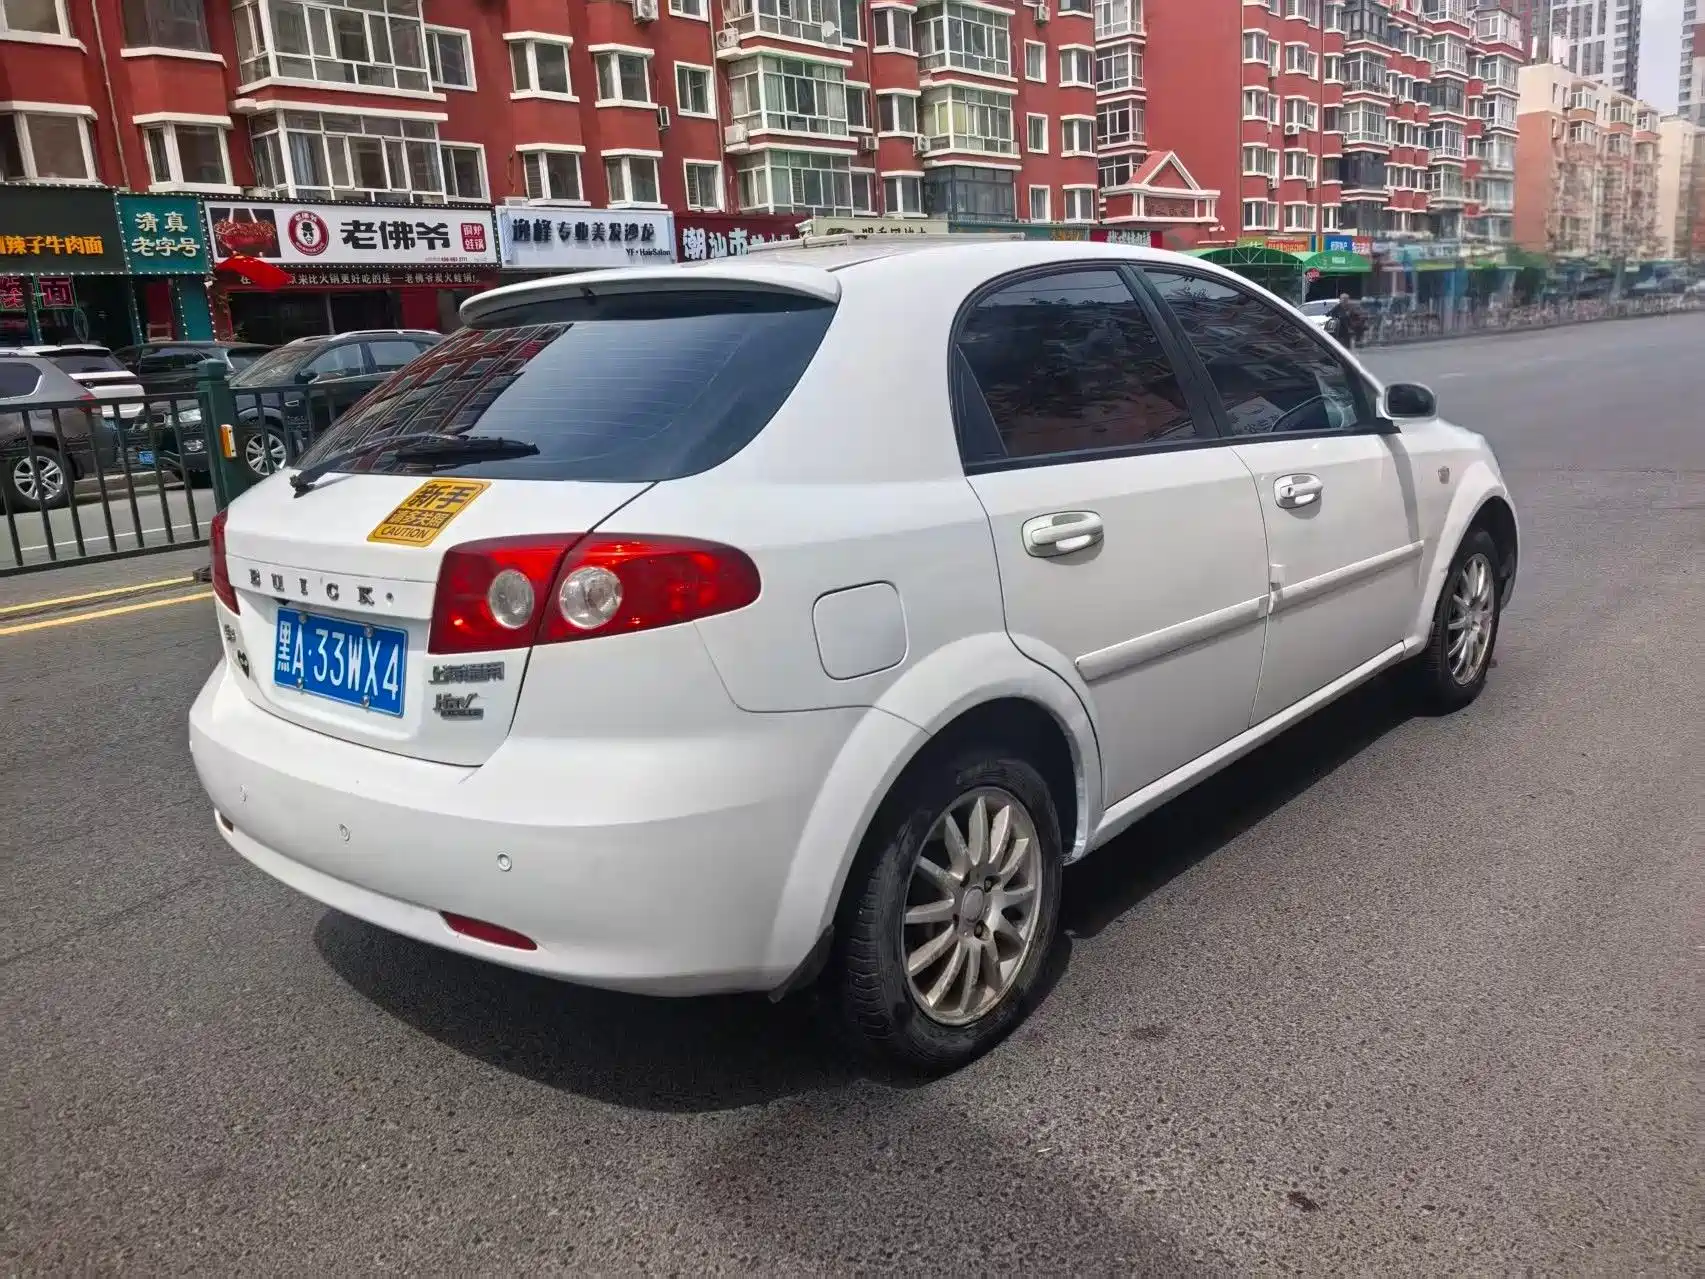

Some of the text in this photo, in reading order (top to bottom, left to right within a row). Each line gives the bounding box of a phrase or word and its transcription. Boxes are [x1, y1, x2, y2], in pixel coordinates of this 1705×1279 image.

[135, 211, 188, 232] 清真
[340, 219, 451, 250] 老佛爷
[132, 236, 200, 258] 老字号
[407, 483, 478, 510] 新手
[381, 526, 429, 539] CAUTION
[248, 568, 375, 607] BUICK
